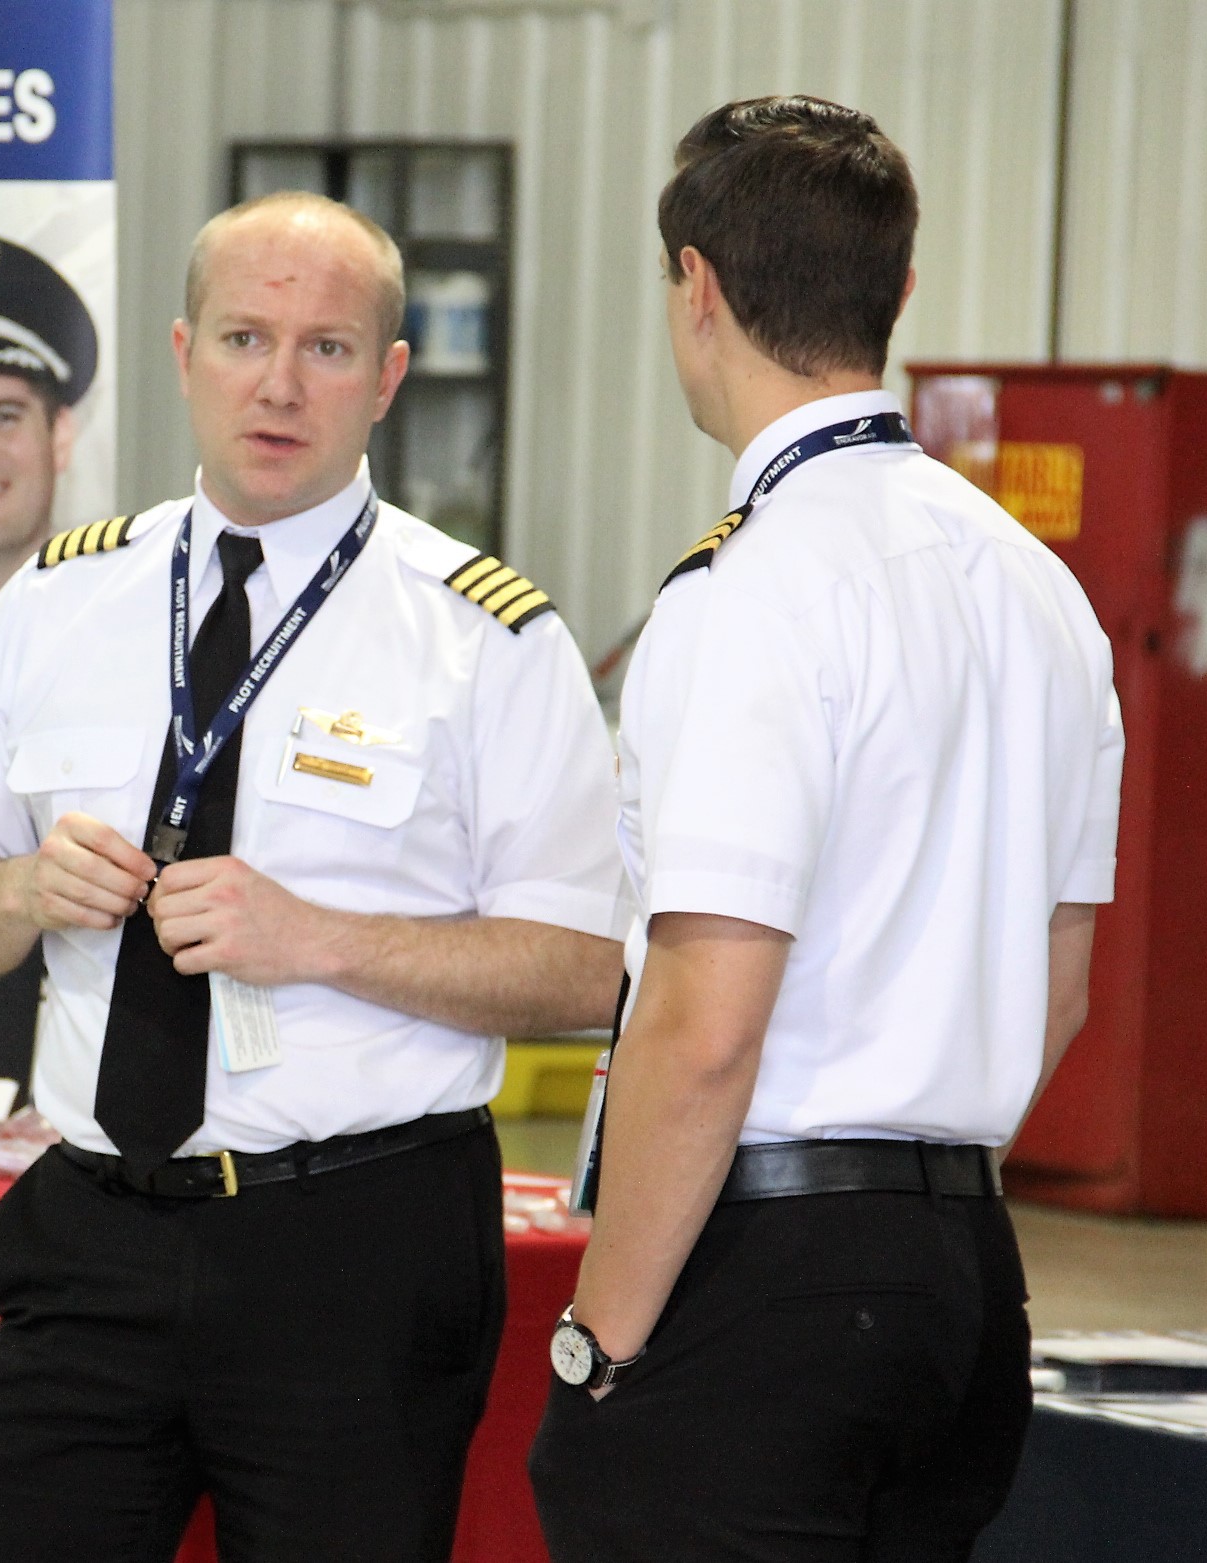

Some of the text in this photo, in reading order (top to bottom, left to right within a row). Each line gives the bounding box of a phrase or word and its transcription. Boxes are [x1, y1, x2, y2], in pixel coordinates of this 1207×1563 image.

[750, 445, 803, 505] RUITMENT
[228, 606, 308, 714] PILOT RECRUITMENT
